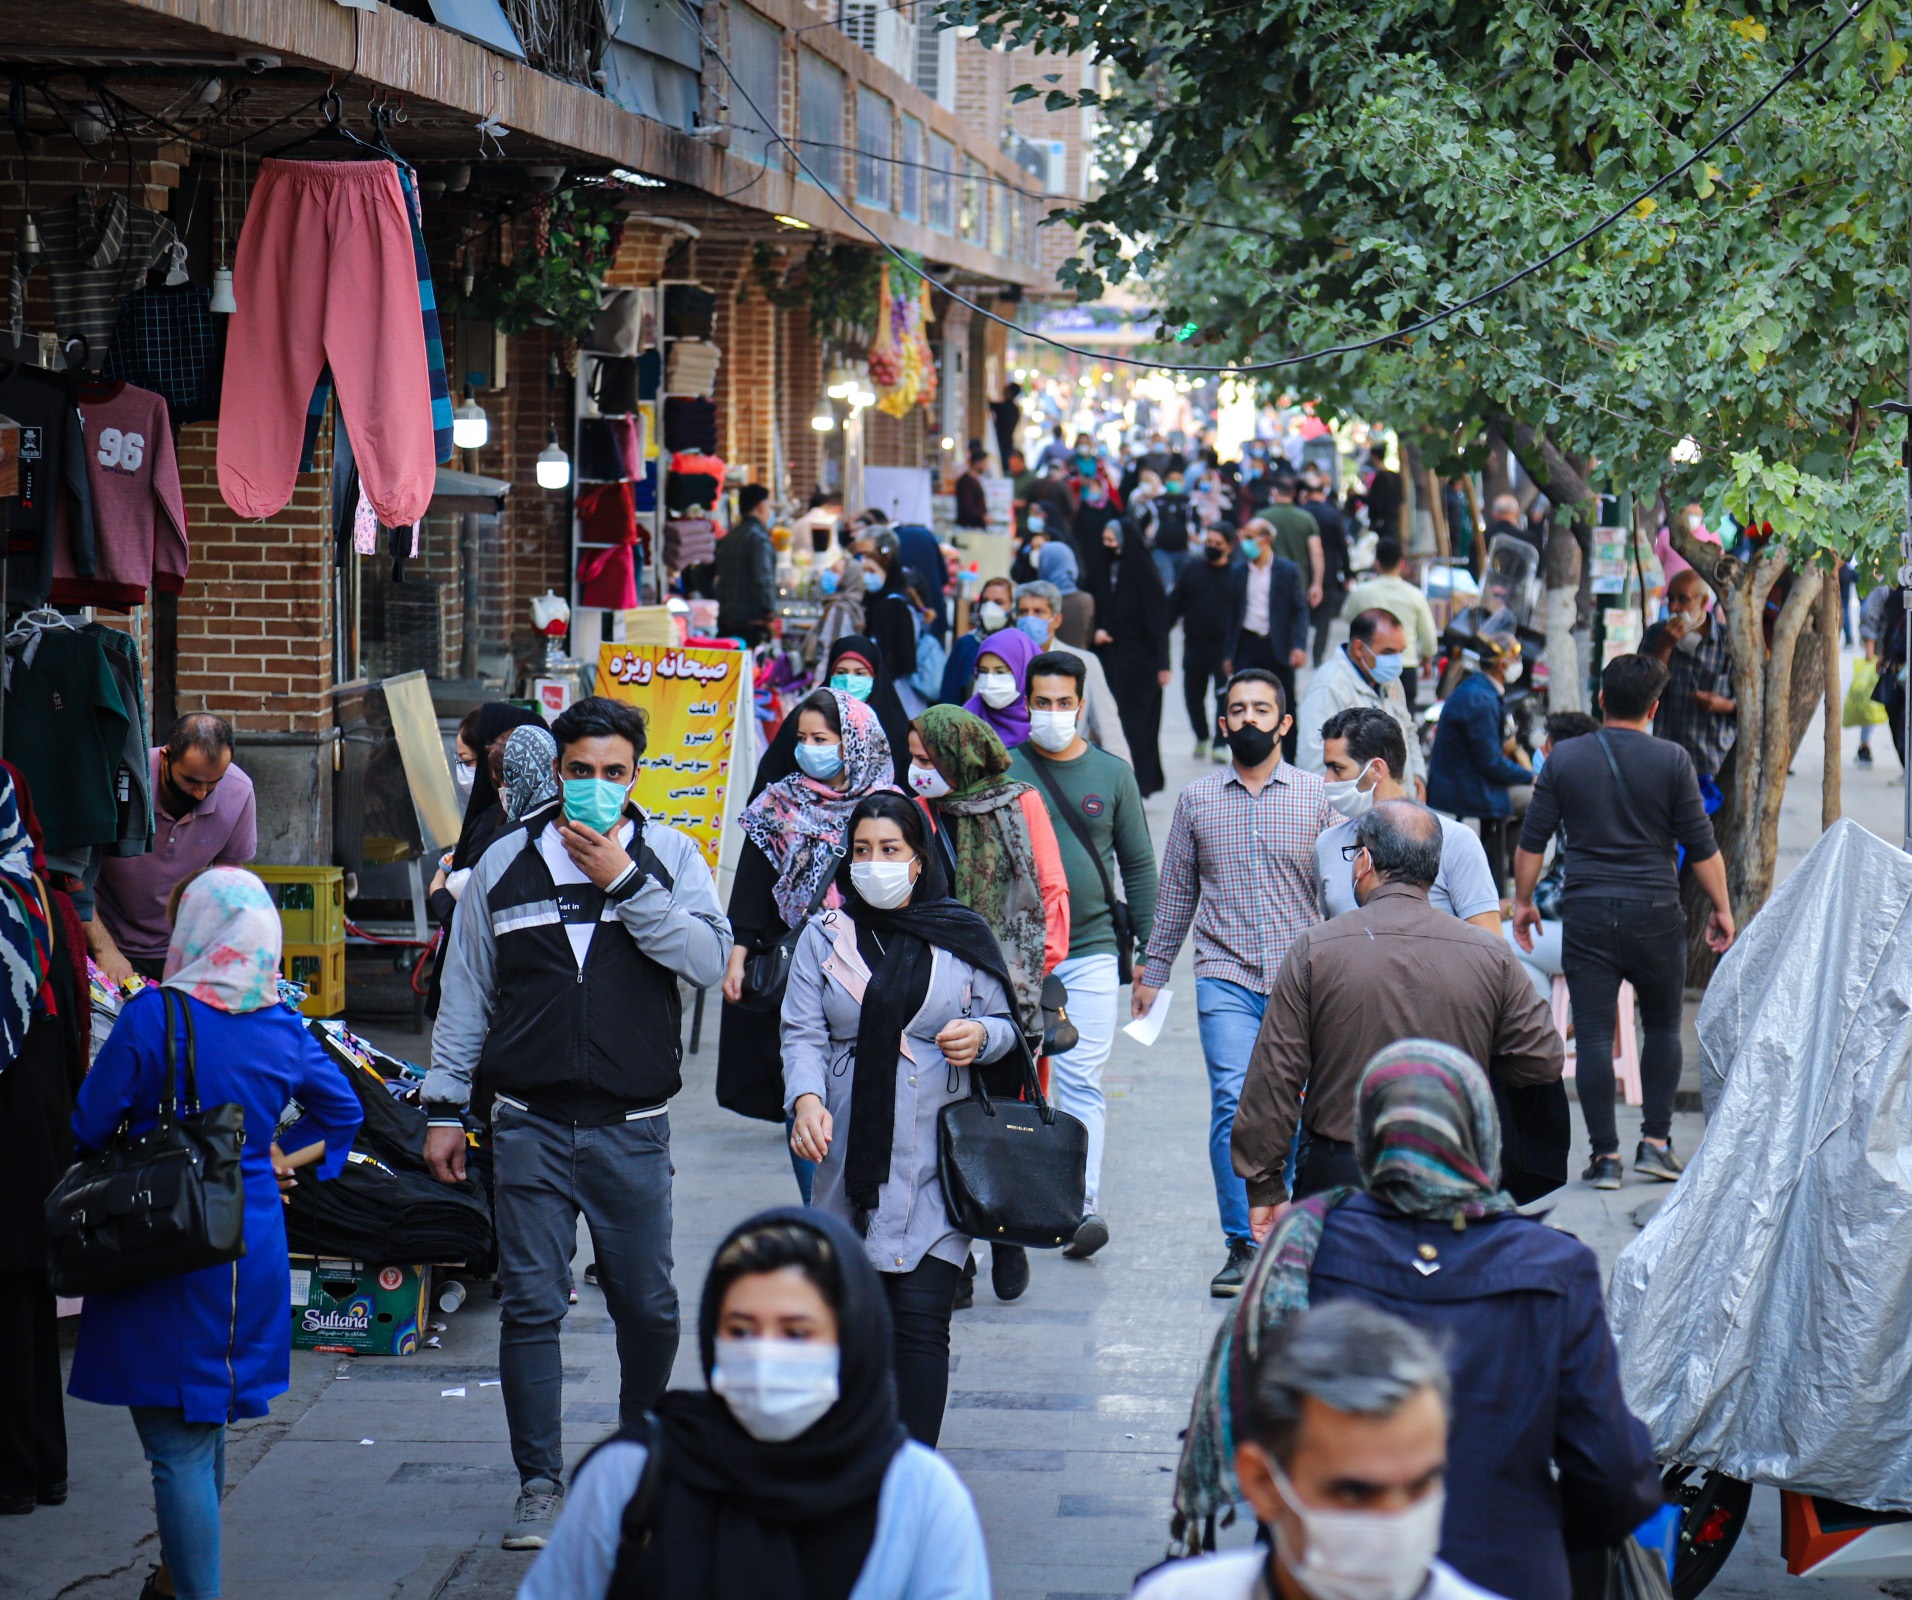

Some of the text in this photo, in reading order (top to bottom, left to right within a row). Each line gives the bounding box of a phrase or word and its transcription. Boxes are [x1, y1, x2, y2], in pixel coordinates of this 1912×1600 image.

[97, 427, 145, 471] 96
[610, 651, 728, 686] صبحانه ویژه
[688, 702, 717, 715] املت
[724, 731, 731, 745] ۲
[719, 761, 728, 774] ۳
[669, 787, 723, 799] ۴ عدسی
[712, 816, 720, 828] ۵
[302, 1309, 369, 1331] Sultana
